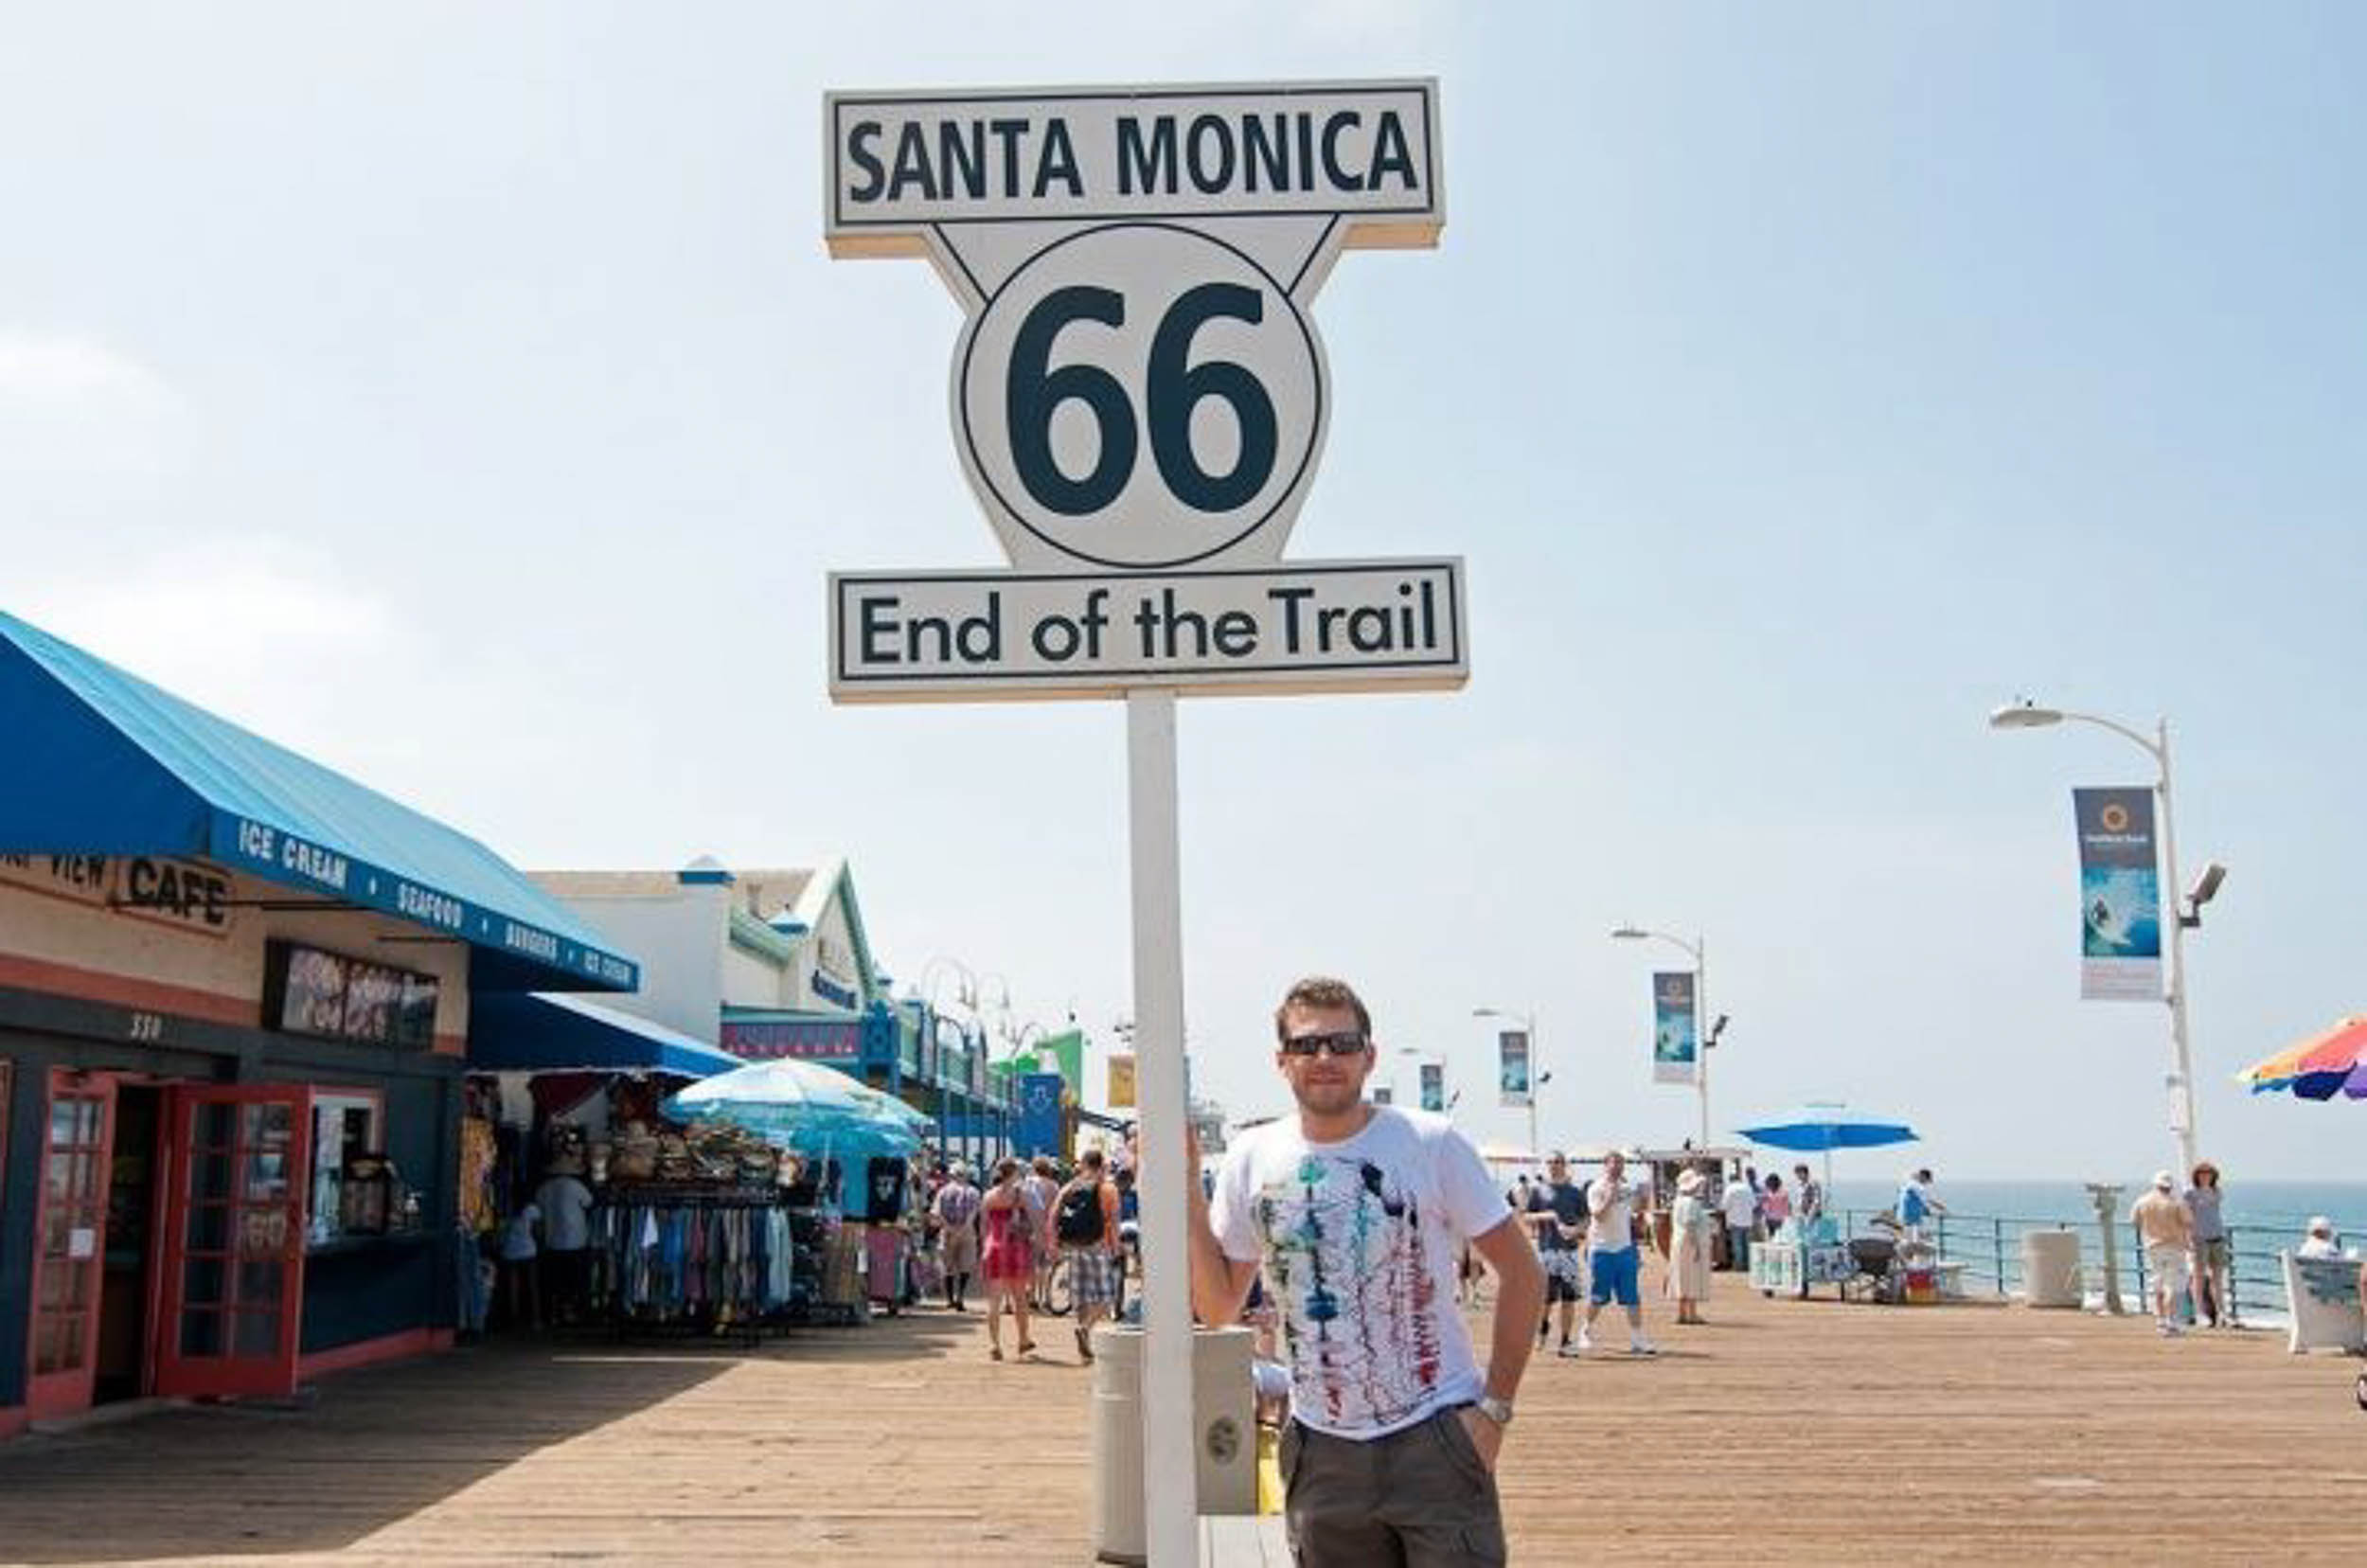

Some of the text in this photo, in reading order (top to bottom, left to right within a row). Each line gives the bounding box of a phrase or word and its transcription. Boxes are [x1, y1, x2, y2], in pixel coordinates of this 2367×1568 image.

[847, 111, 1418, 204] SANTA MONICA
[1006, 281, 1279, 517] 66
[860, 579, 1436, 664] End of the Trail
[129, 857, 226, 925] CAFE
[239, 820, 275, 861] ICE
[282, 837, 347, 890] CREAM
[397, 882, 463, 929] SEAFOOD
